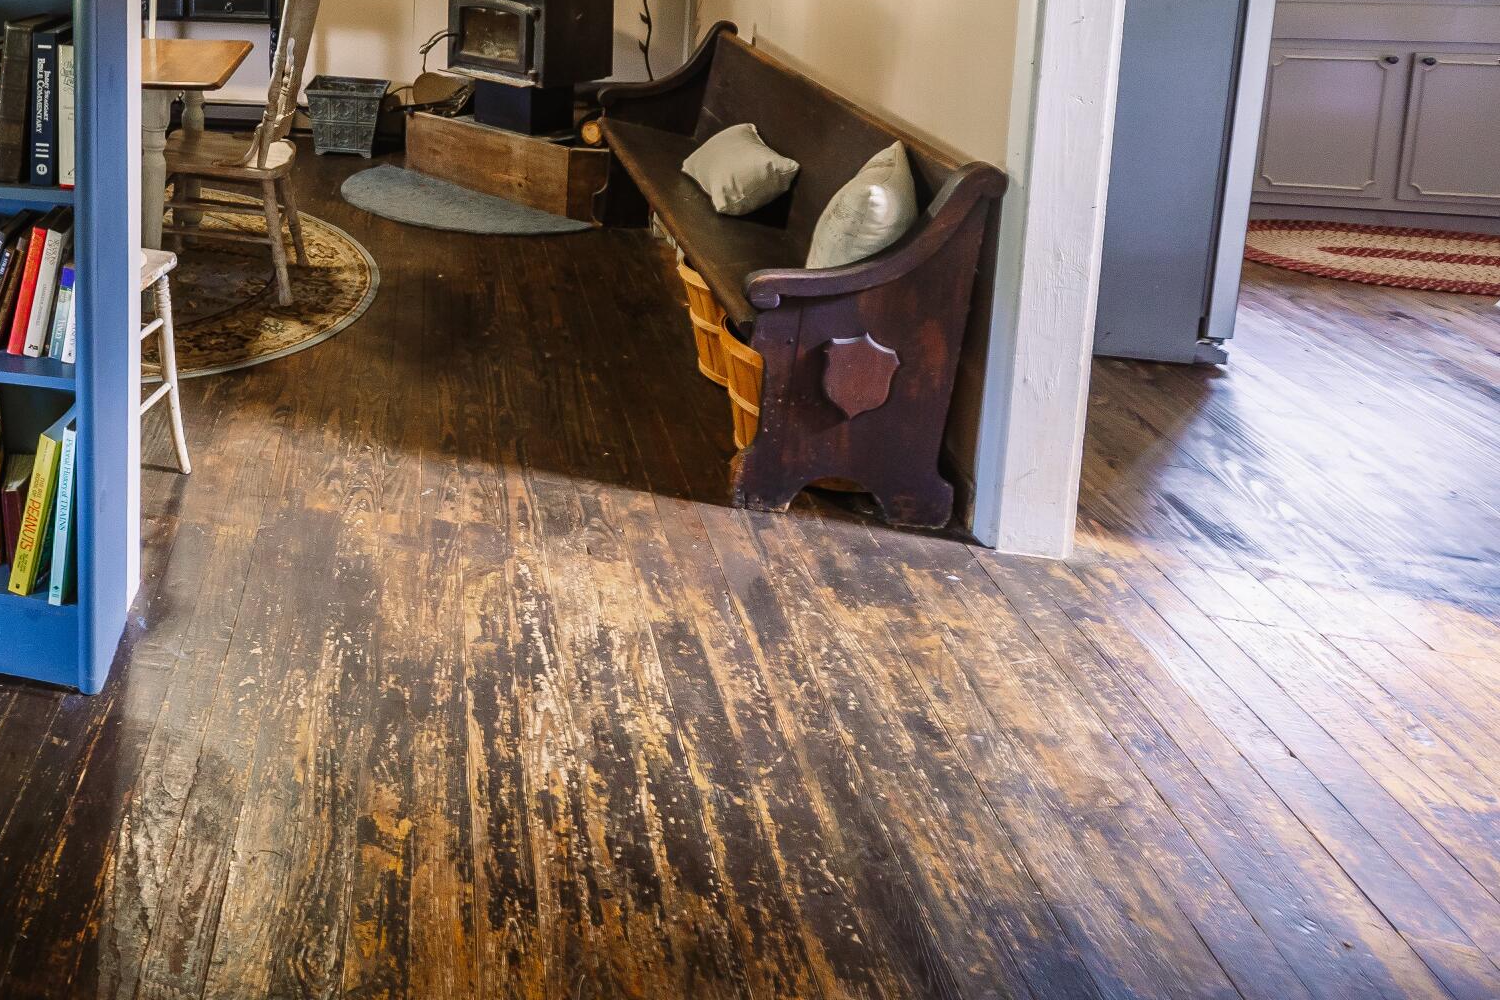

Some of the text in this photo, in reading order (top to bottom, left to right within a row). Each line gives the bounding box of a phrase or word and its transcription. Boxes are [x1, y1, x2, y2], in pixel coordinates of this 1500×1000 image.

[36, 57, 45, 134] BIBLE COMMENTARY
[65, 438, 73, 464] Pictorial
[61, 466, 72, 491] History
[20, 498, 41, 552] PEANUTS
[59, 499, 69, 532] TRAINS
